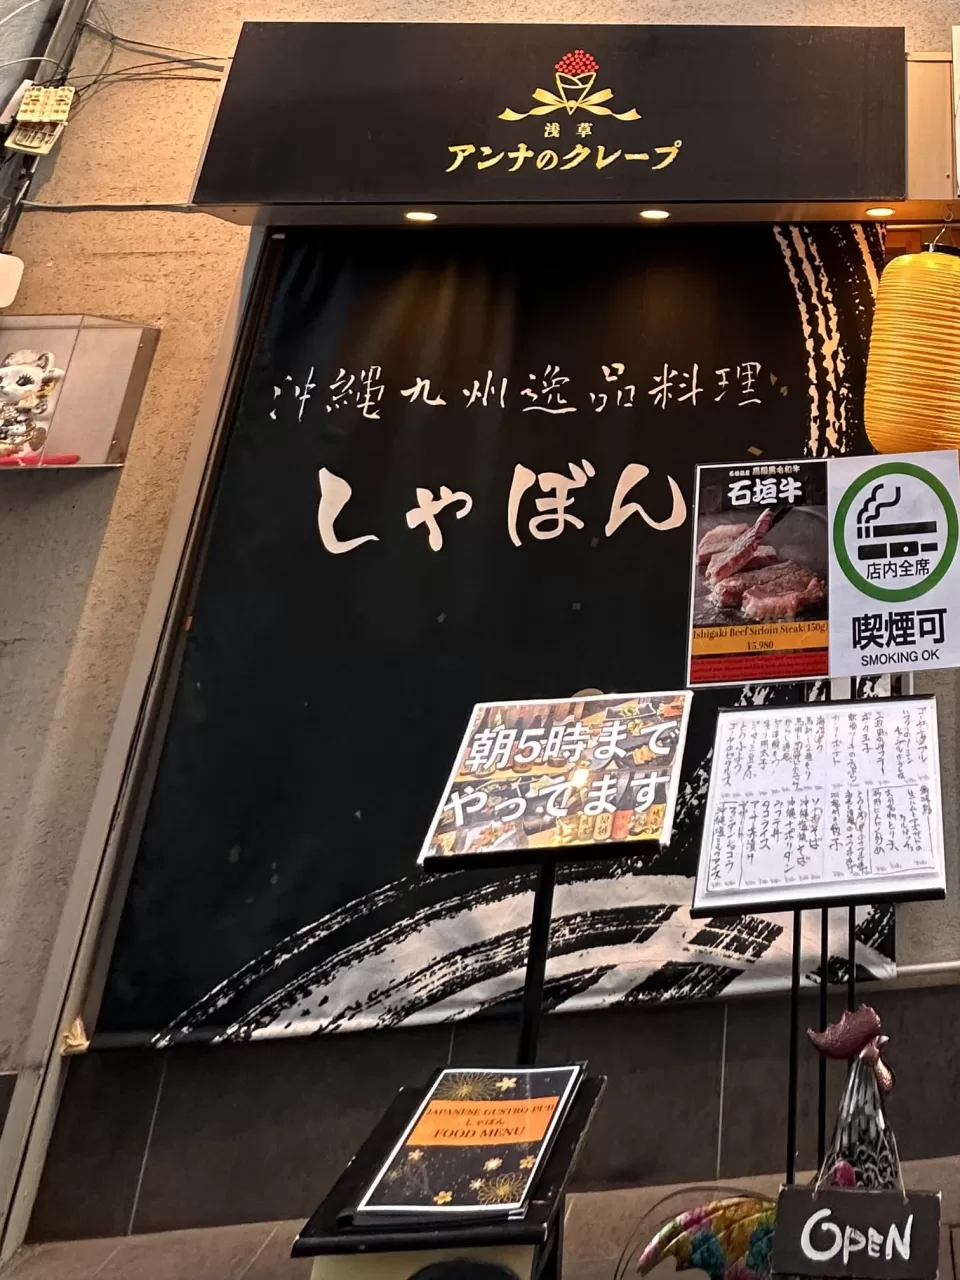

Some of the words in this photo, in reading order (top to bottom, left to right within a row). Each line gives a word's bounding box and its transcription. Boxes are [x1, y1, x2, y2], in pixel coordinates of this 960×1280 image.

[544, 122, 593, 138] 浅草
[445, 139, 684, 173] アンナのクレープ
[269, 361, 764, 422] 沖縄九州逸品料理
[316, 458, 689, 555] しゃぼん
[727, 477, 803, 506] 石垣牛
[866, 558, 931, 581] 店内全席
[693, 629, 728, 641] Ishigaki
[729, 627, 748, 637] Beef
[749, 625, 779, 636] Sirloin
[852, 608, 948, 651] 喫煙可
[861, 650, 919, 667] SMOKING
[921, 649, 940, 662] OK
[464, 720, 681, 773] 朝5時まで
[443, 772, 671, 827] やってます
[427, 1108, 480, 1117] JAPANESE
[433, 1128, 477, 1139] FOOD
[480, 1126, 526, 1138] MENU
[800, 1207, 914, 1265] OPEN
